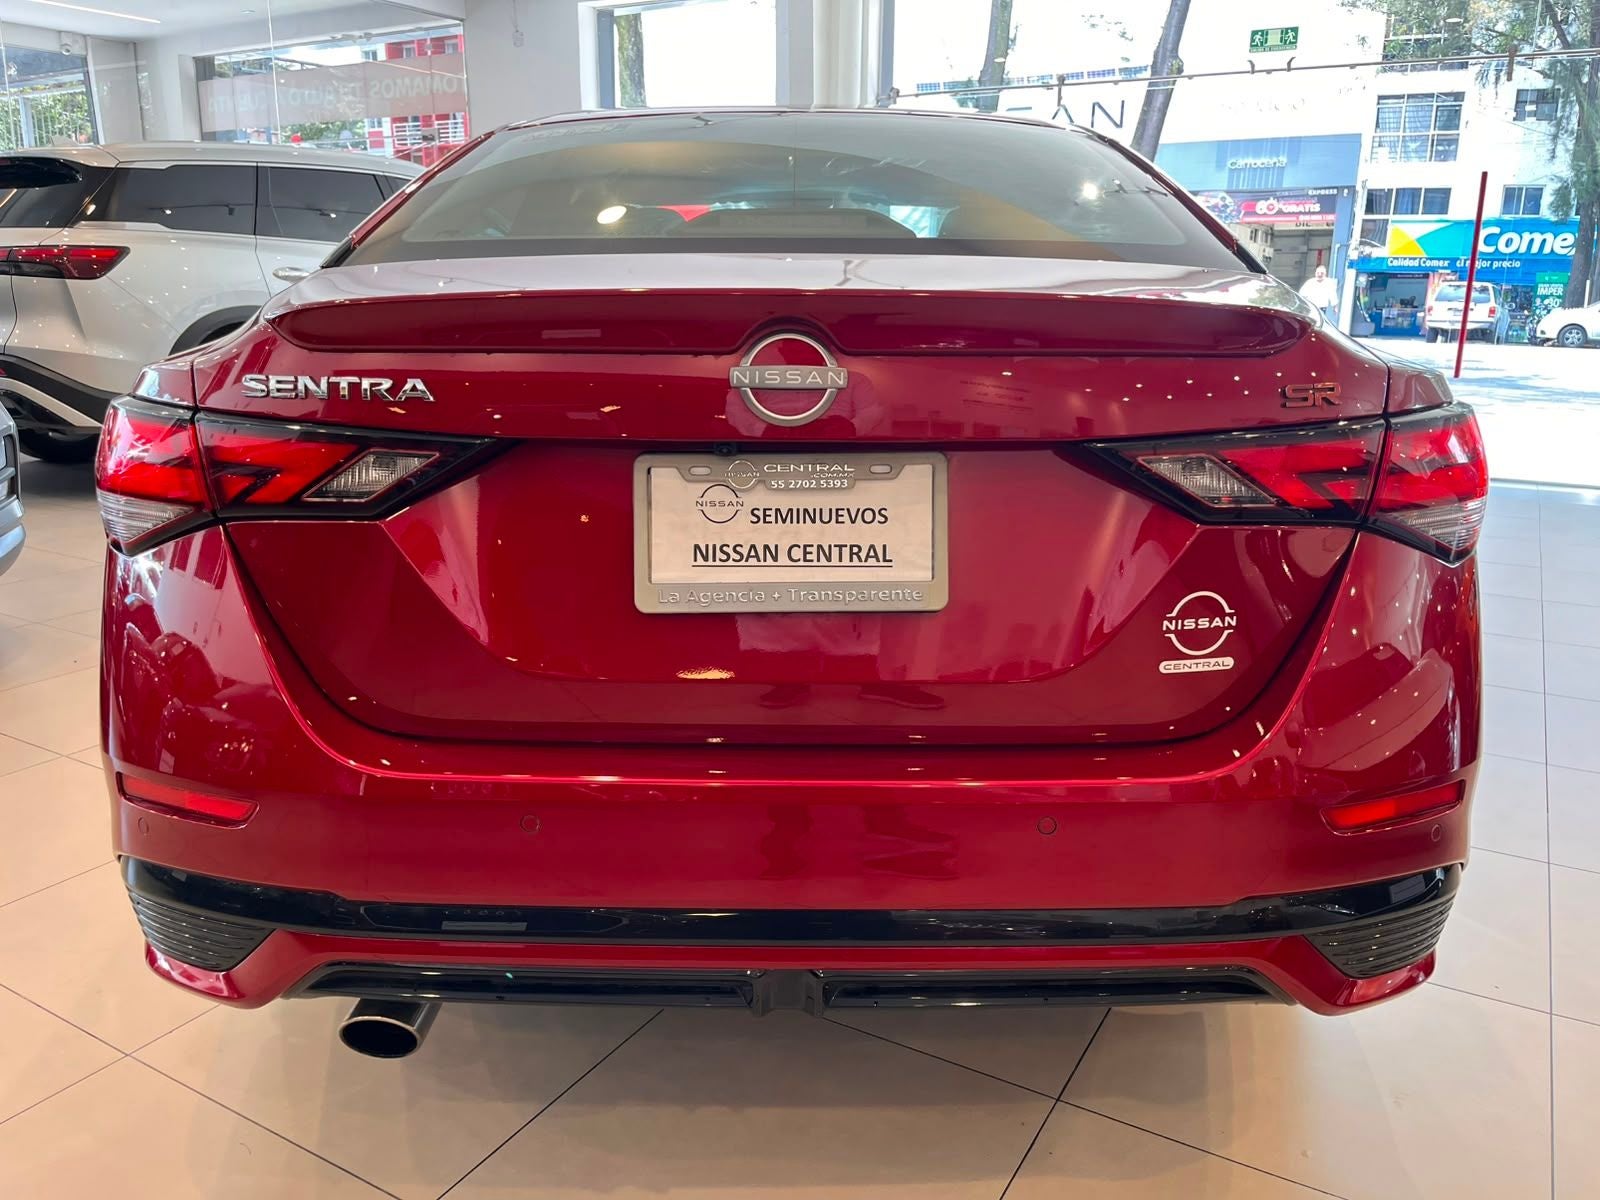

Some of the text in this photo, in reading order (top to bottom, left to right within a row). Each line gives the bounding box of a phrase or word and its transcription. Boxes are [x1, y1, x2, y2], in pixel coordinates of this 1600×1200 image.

[1387, 257, 1420, 267] Calidad
[1420, 257, 1449, 267] Comex
[1493, 258, 1521, 270] precio
[733, 370, 844, 385] NISSAN
[241, 373, 436, 402] SENTRA
[1282, 382, 1342, 408] SR
[763, 463, 856, 473] CENTRAL
[770, 479, 848, 489] 55 2702 5393
[695, 500, 744, 508] NISSAN
[750, 507, 889, 525] SEMINUEVOS
[692, 543, 893, 563] NISSAN CENTRAL
[658, 589, 680, 603] La
[685, 589, 765, 607] Agencia
[787, 588, 923, 605] Transparente
[1162, 615, 1237, 631] NISSAN
[1163, 660, 1231, 671] CENTRAL
